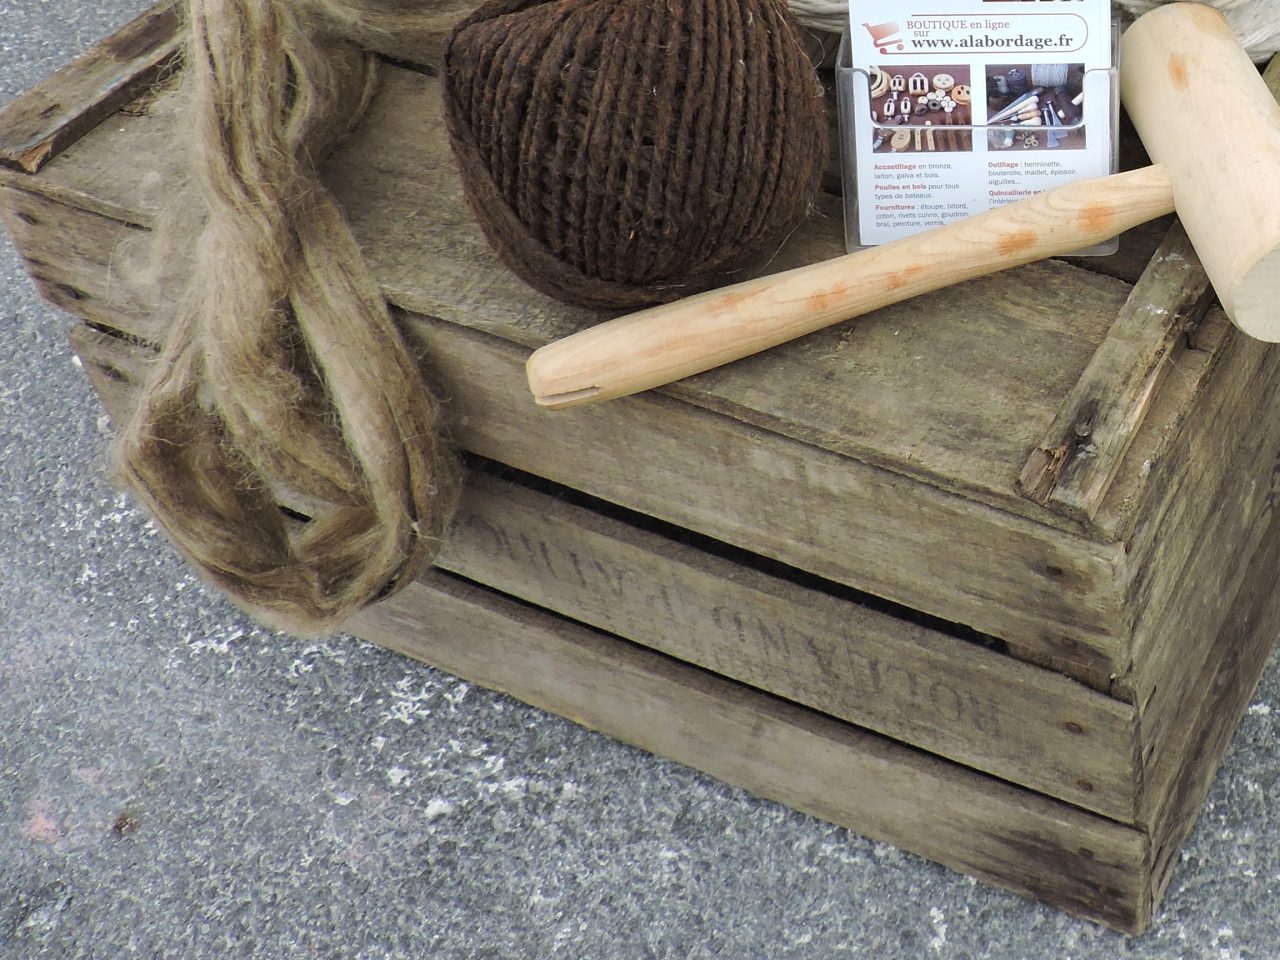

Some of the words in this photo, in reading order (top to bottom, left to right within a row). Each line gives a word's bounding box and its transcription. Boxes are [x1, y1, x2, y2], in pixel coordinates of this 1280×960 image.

[906, 20, 968, 31] BOUTIQUE
[984, 20, 1010, 31] ligne
[911, 34, 1074, 50] www.alabordage.fr
[874, 163, 917, 171] Accastillage
[988, 189, 1032, 197] Quincaillerie
